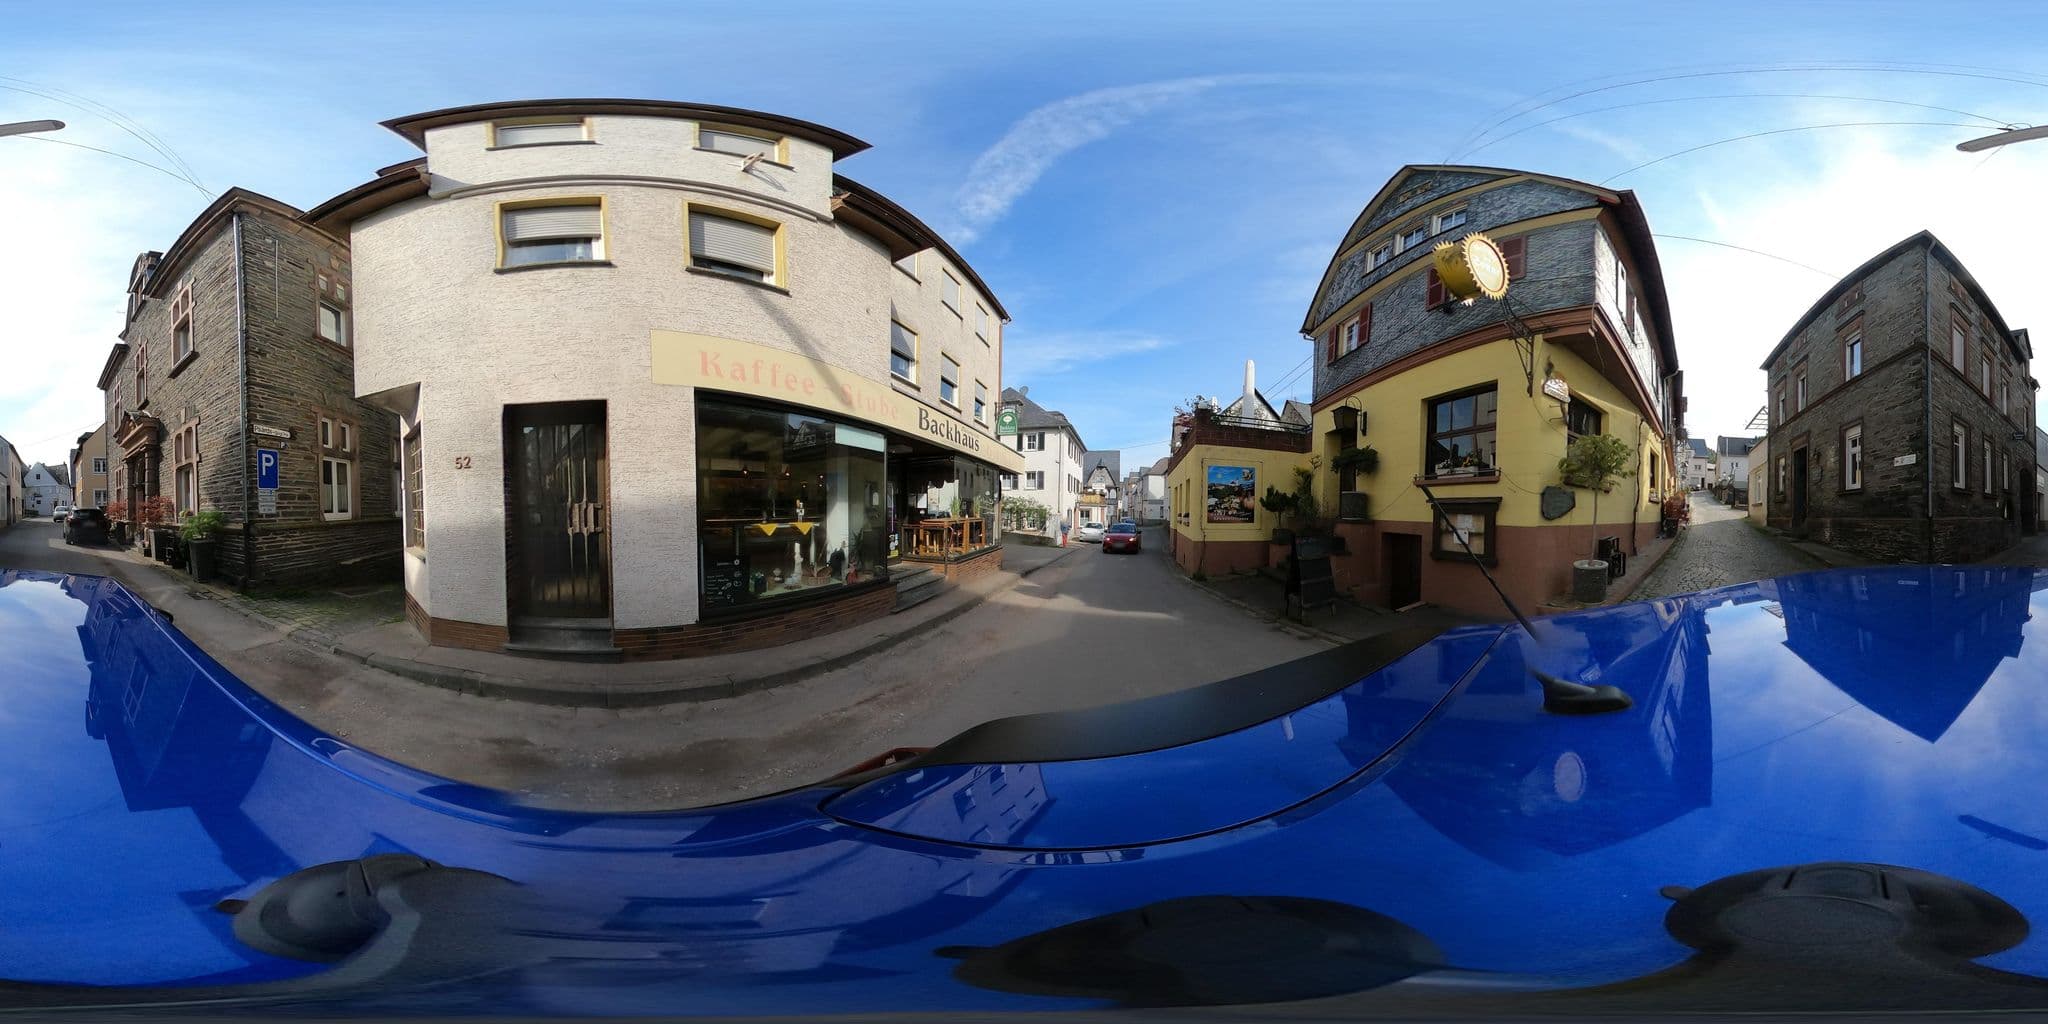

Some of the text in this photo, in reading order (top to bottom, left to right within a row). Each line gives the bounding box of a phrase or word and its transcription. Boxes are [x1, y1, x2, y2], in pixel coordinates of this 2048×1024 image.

[699, 351, 816, 395] Kaffee
[918, 407, 981, 452] Backhaus
[262, 453, 274, 476] P
[455, 456, 472, 470] 52
